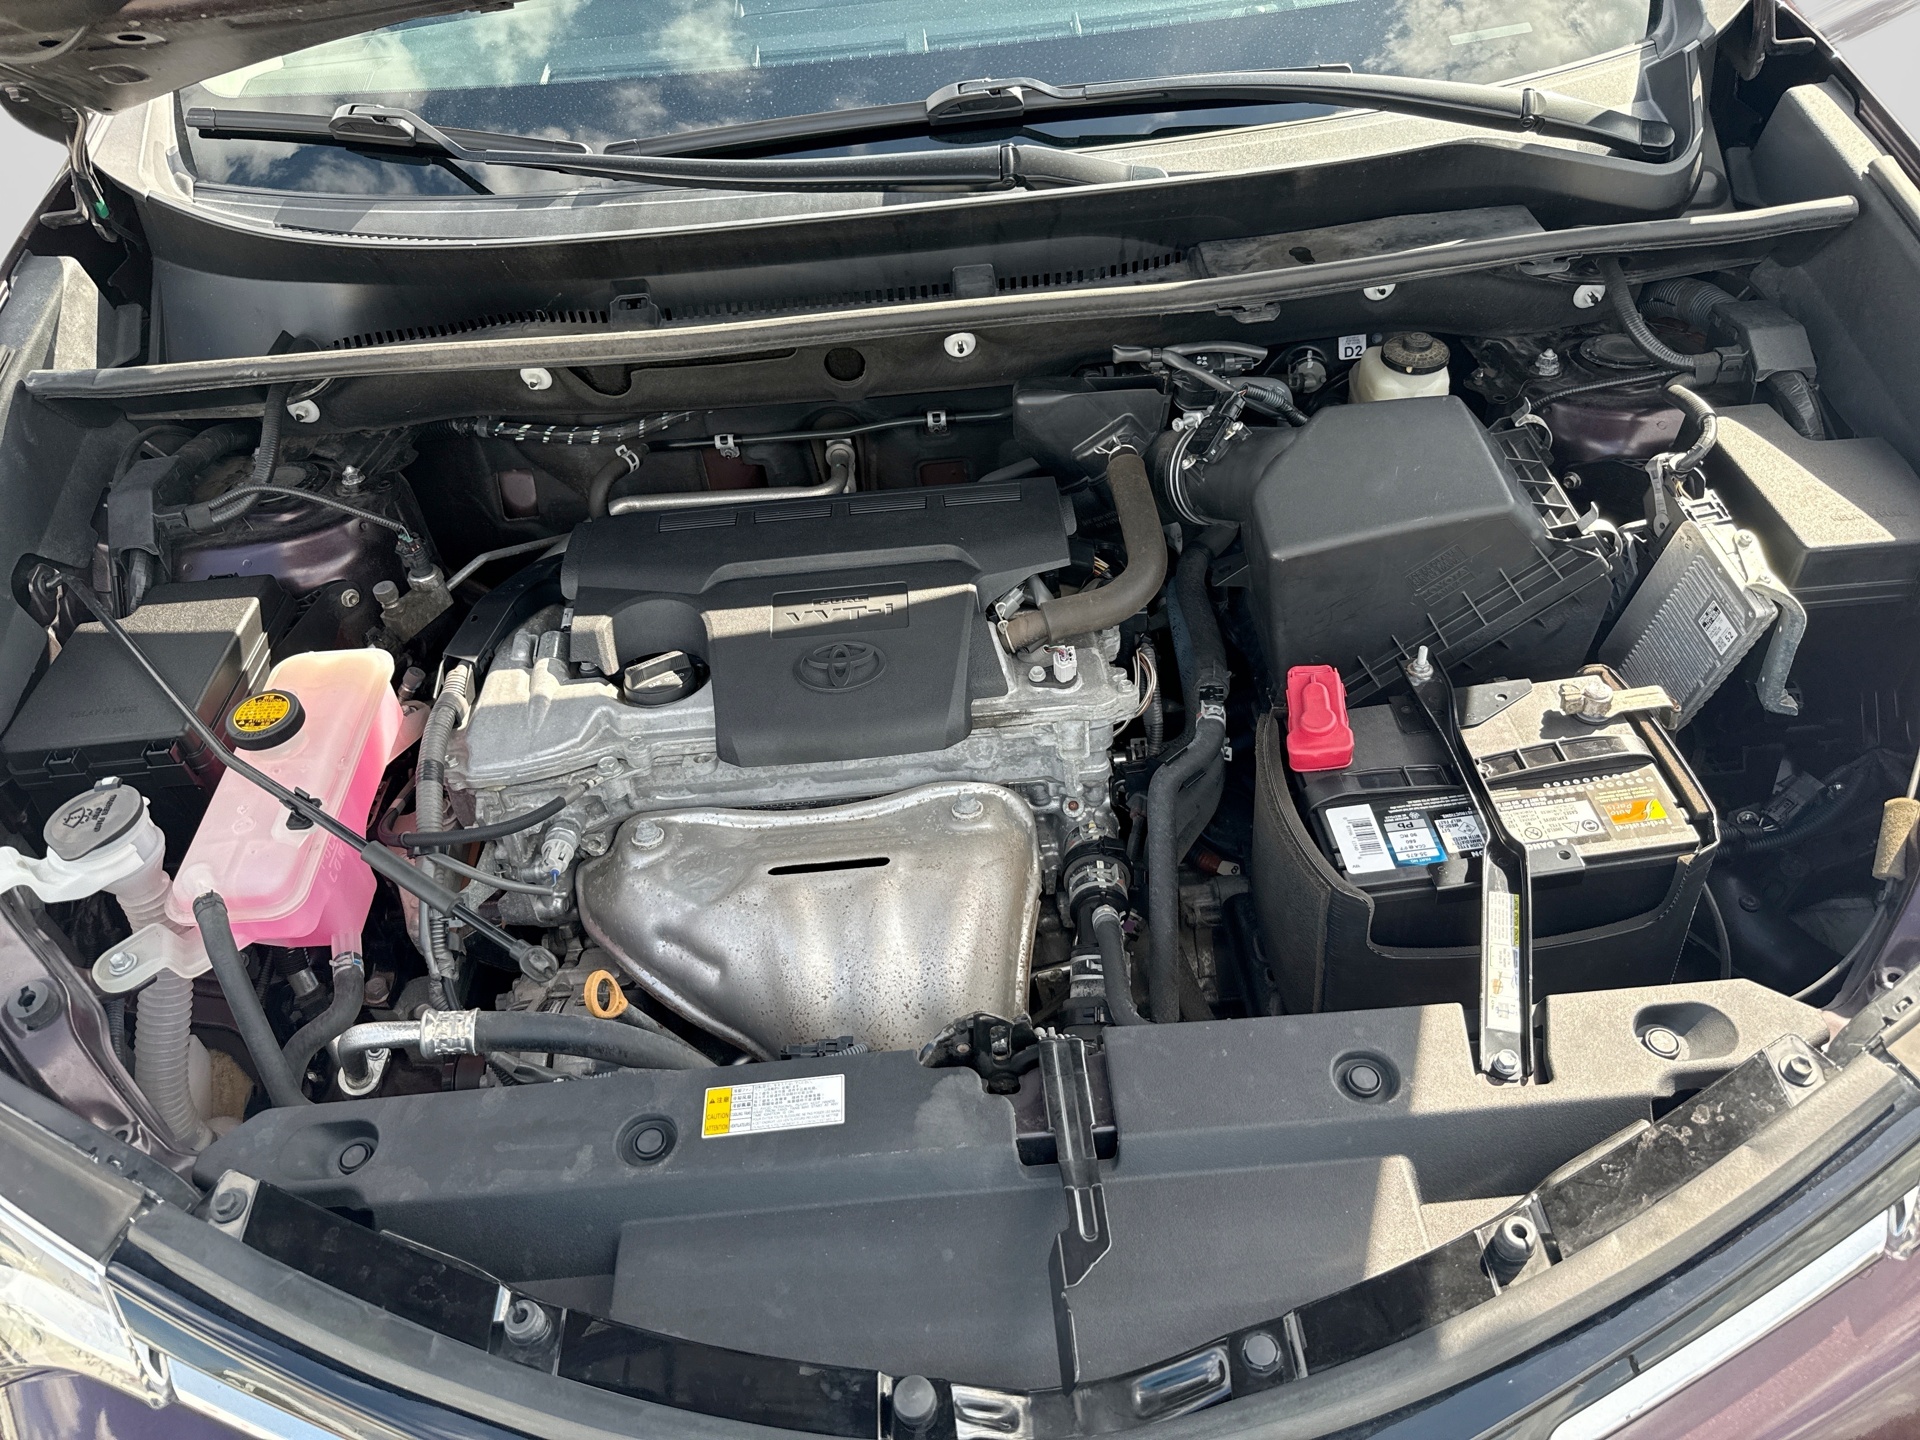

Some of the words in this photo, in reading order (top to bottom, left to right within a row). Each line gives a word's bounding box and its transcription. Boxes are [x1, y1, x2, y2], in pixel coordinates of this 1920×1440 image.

[1344, 346, 1362, 358] D2
[1422, 567, 1468, 595] TOYOTA
[785, 602, 893, 626] VVT-i
[1724, 632, 1734, 642] 52
[1615, 819, 1672, 832] Federated
[1525, 841, 1555, 850] DANG
[707, 1112, 728, 1120] CAUTION
